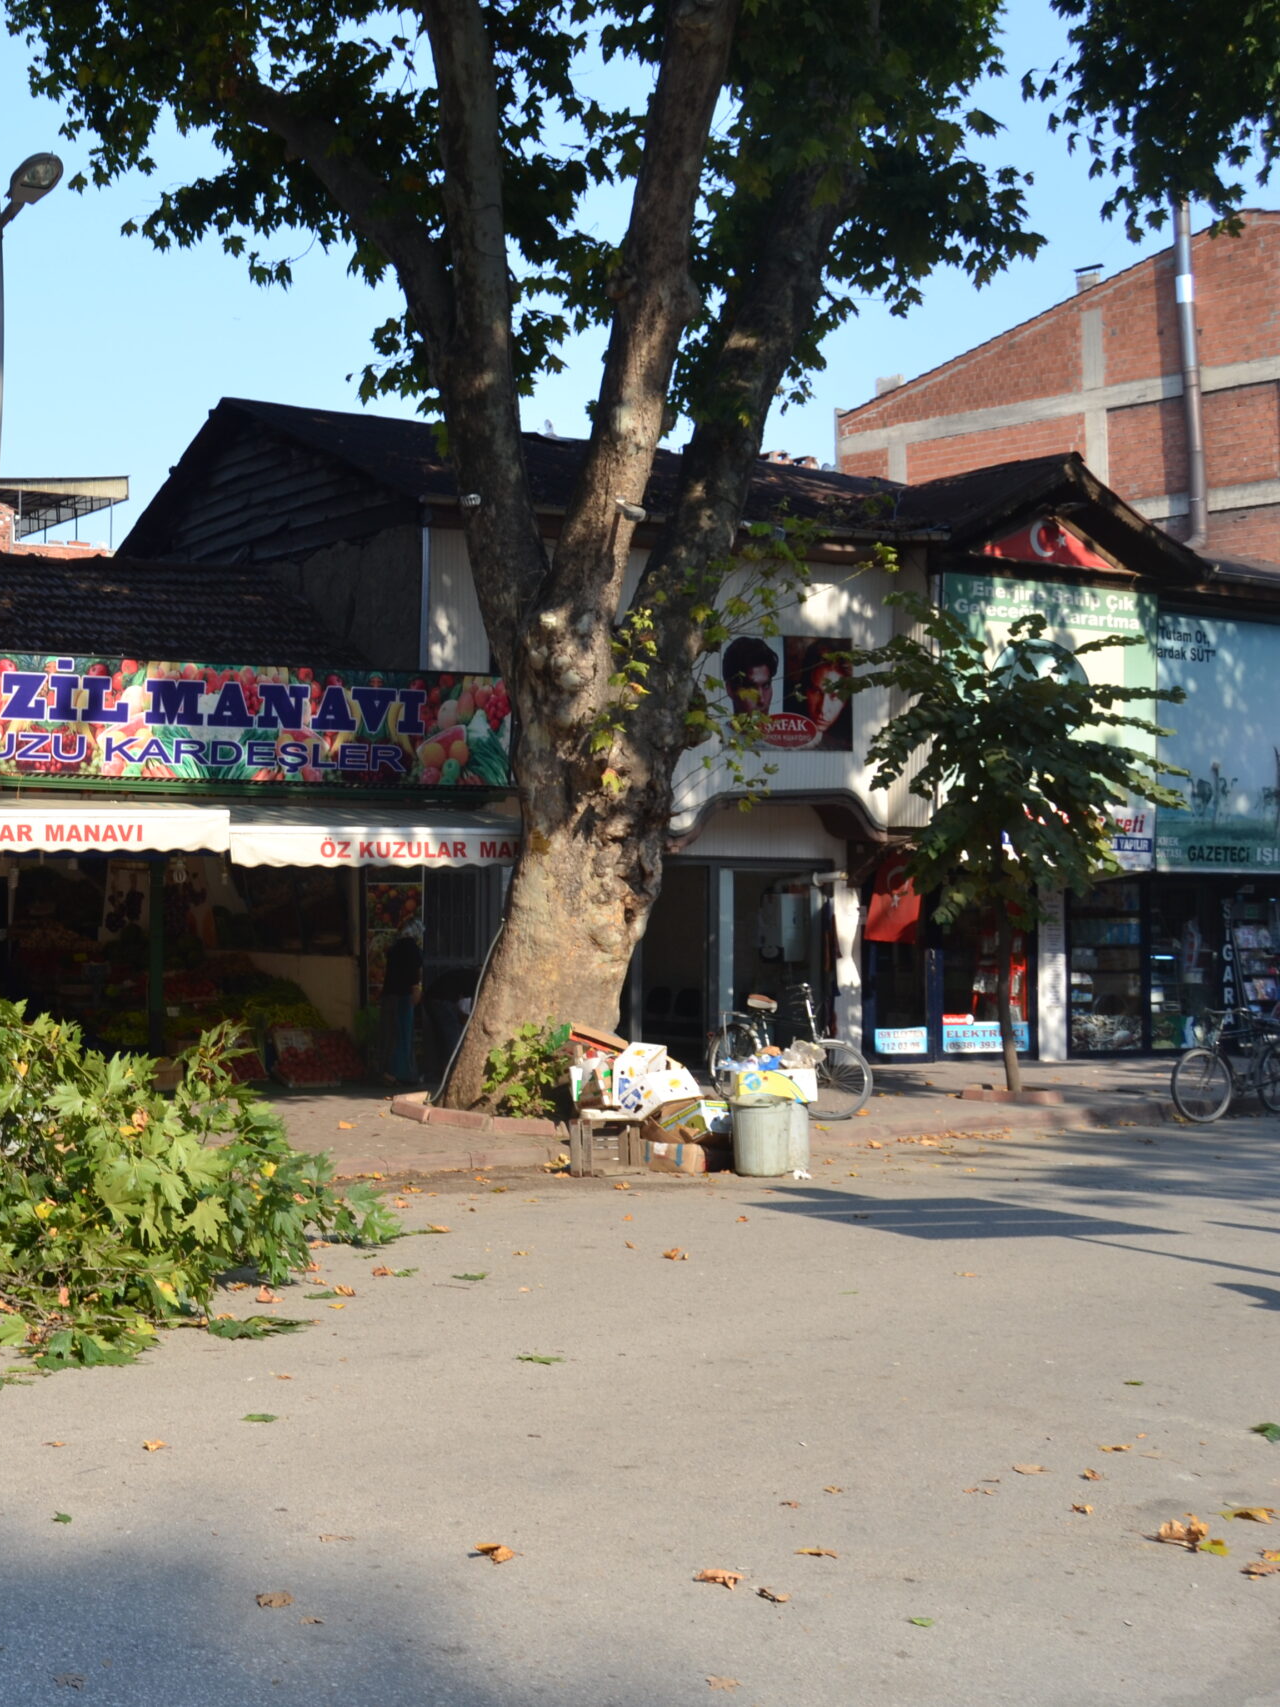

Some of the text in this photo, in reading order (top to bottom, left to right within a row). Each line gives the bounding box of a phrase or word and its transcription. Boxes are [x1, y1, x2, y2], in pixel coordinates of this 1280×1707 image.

[972, 580, 1135, 614] Enerjine Sahip Çık
[1058, 608, 1140, 630] Karartma
[1160, 625, 1192, 643] Tutam
[144, 679, 427, 734] MANAVI
[104, 736, 407, 773] KARDEŞLER
[45, 824, 144, 842] MANAVI
[320, 837, 352, 859] ÖZ
[359, 841, 468, 859] KUZULAR
